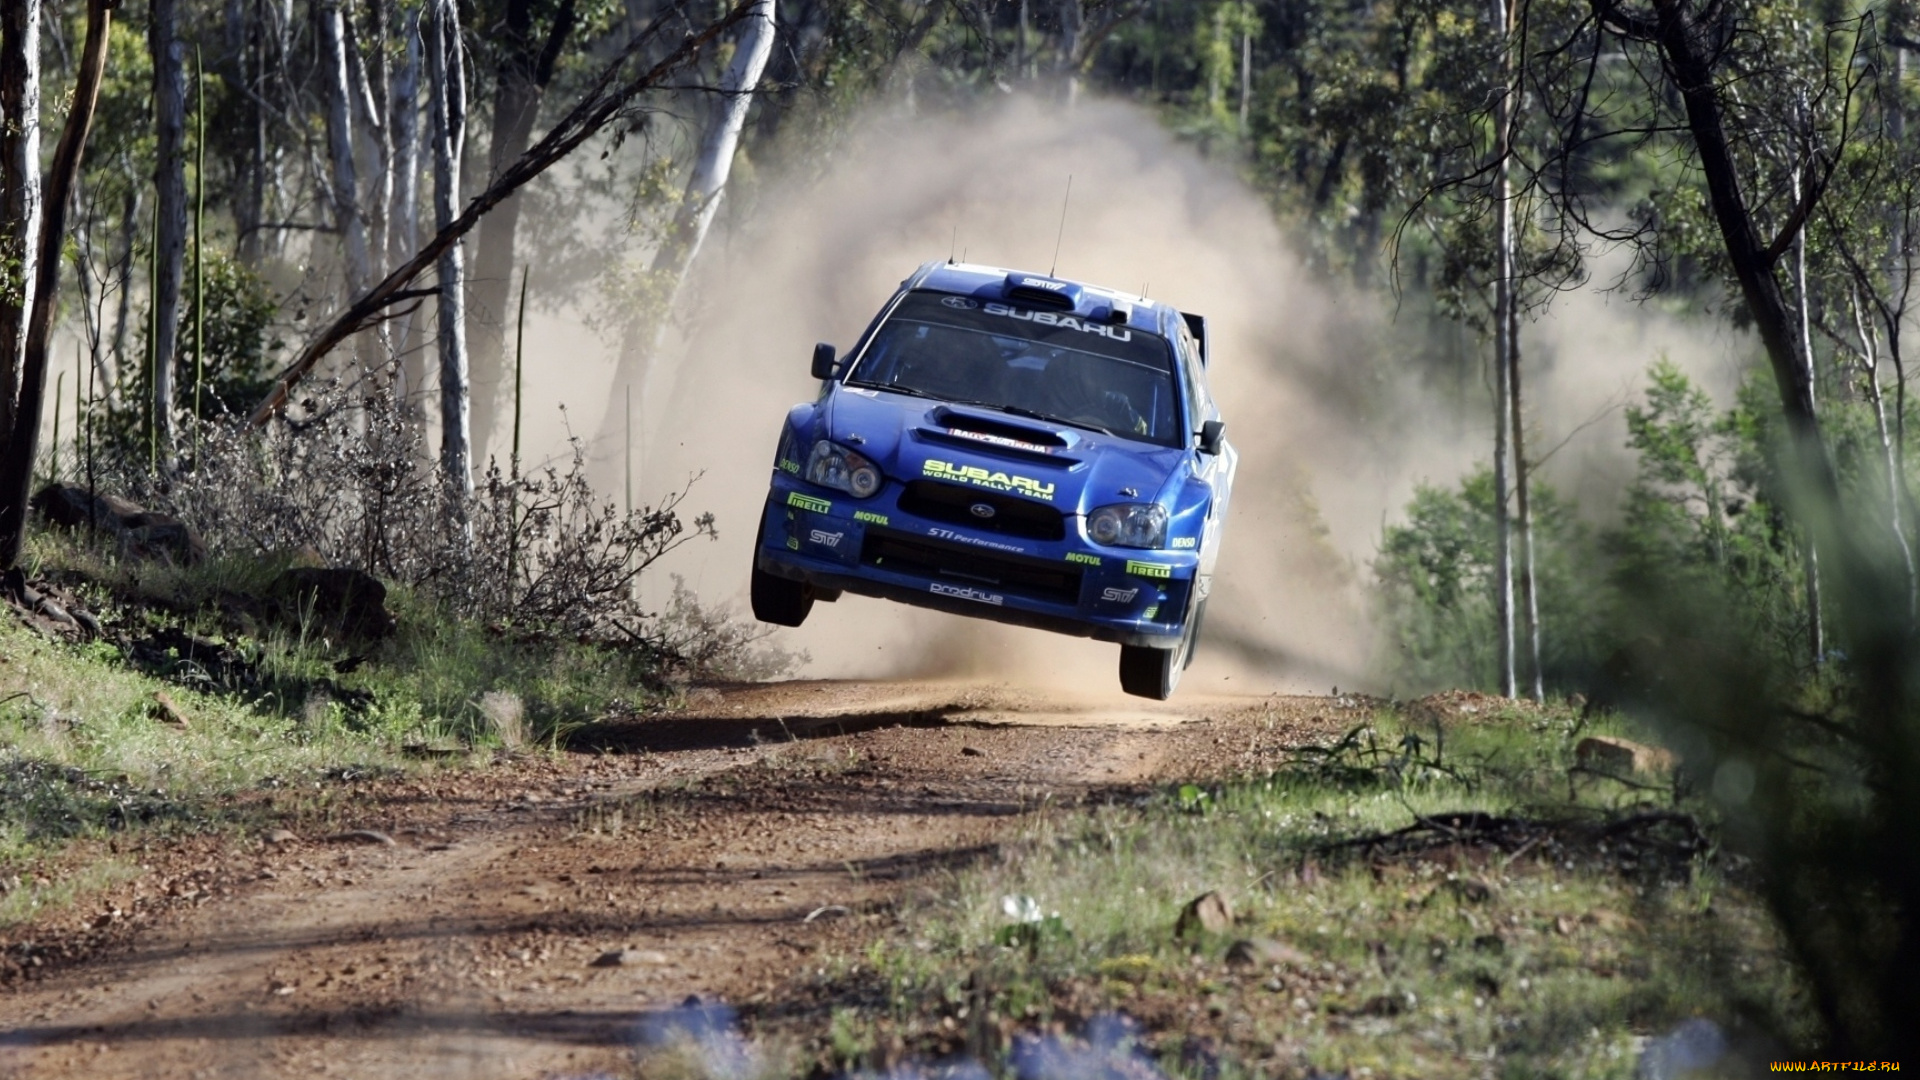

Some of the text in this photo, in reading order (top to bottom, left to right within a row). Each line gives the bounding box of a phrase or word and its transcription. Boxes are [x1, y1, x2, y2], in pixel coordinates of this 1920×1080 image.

[983, 302, 1131, 342] SUBARU
[779, 458, 800, 474] DENSO
[923, 459, 1055, 493] SUBARU
[922, 469, 1053, 500] WORLD RALLY TEAM
[787, 491, 832, 514] PIRELLI
[853, 511, 888, 525] MOTUL
[927, 527, 1024, 552] STI Performance
[1171, 537, 1196, 548] DENSO
[1065, 552, 1101, 566] MOTUL
[1126, 559, 1171, 578] PIRELLI
[929, 582, 1004, 606] prodrive
